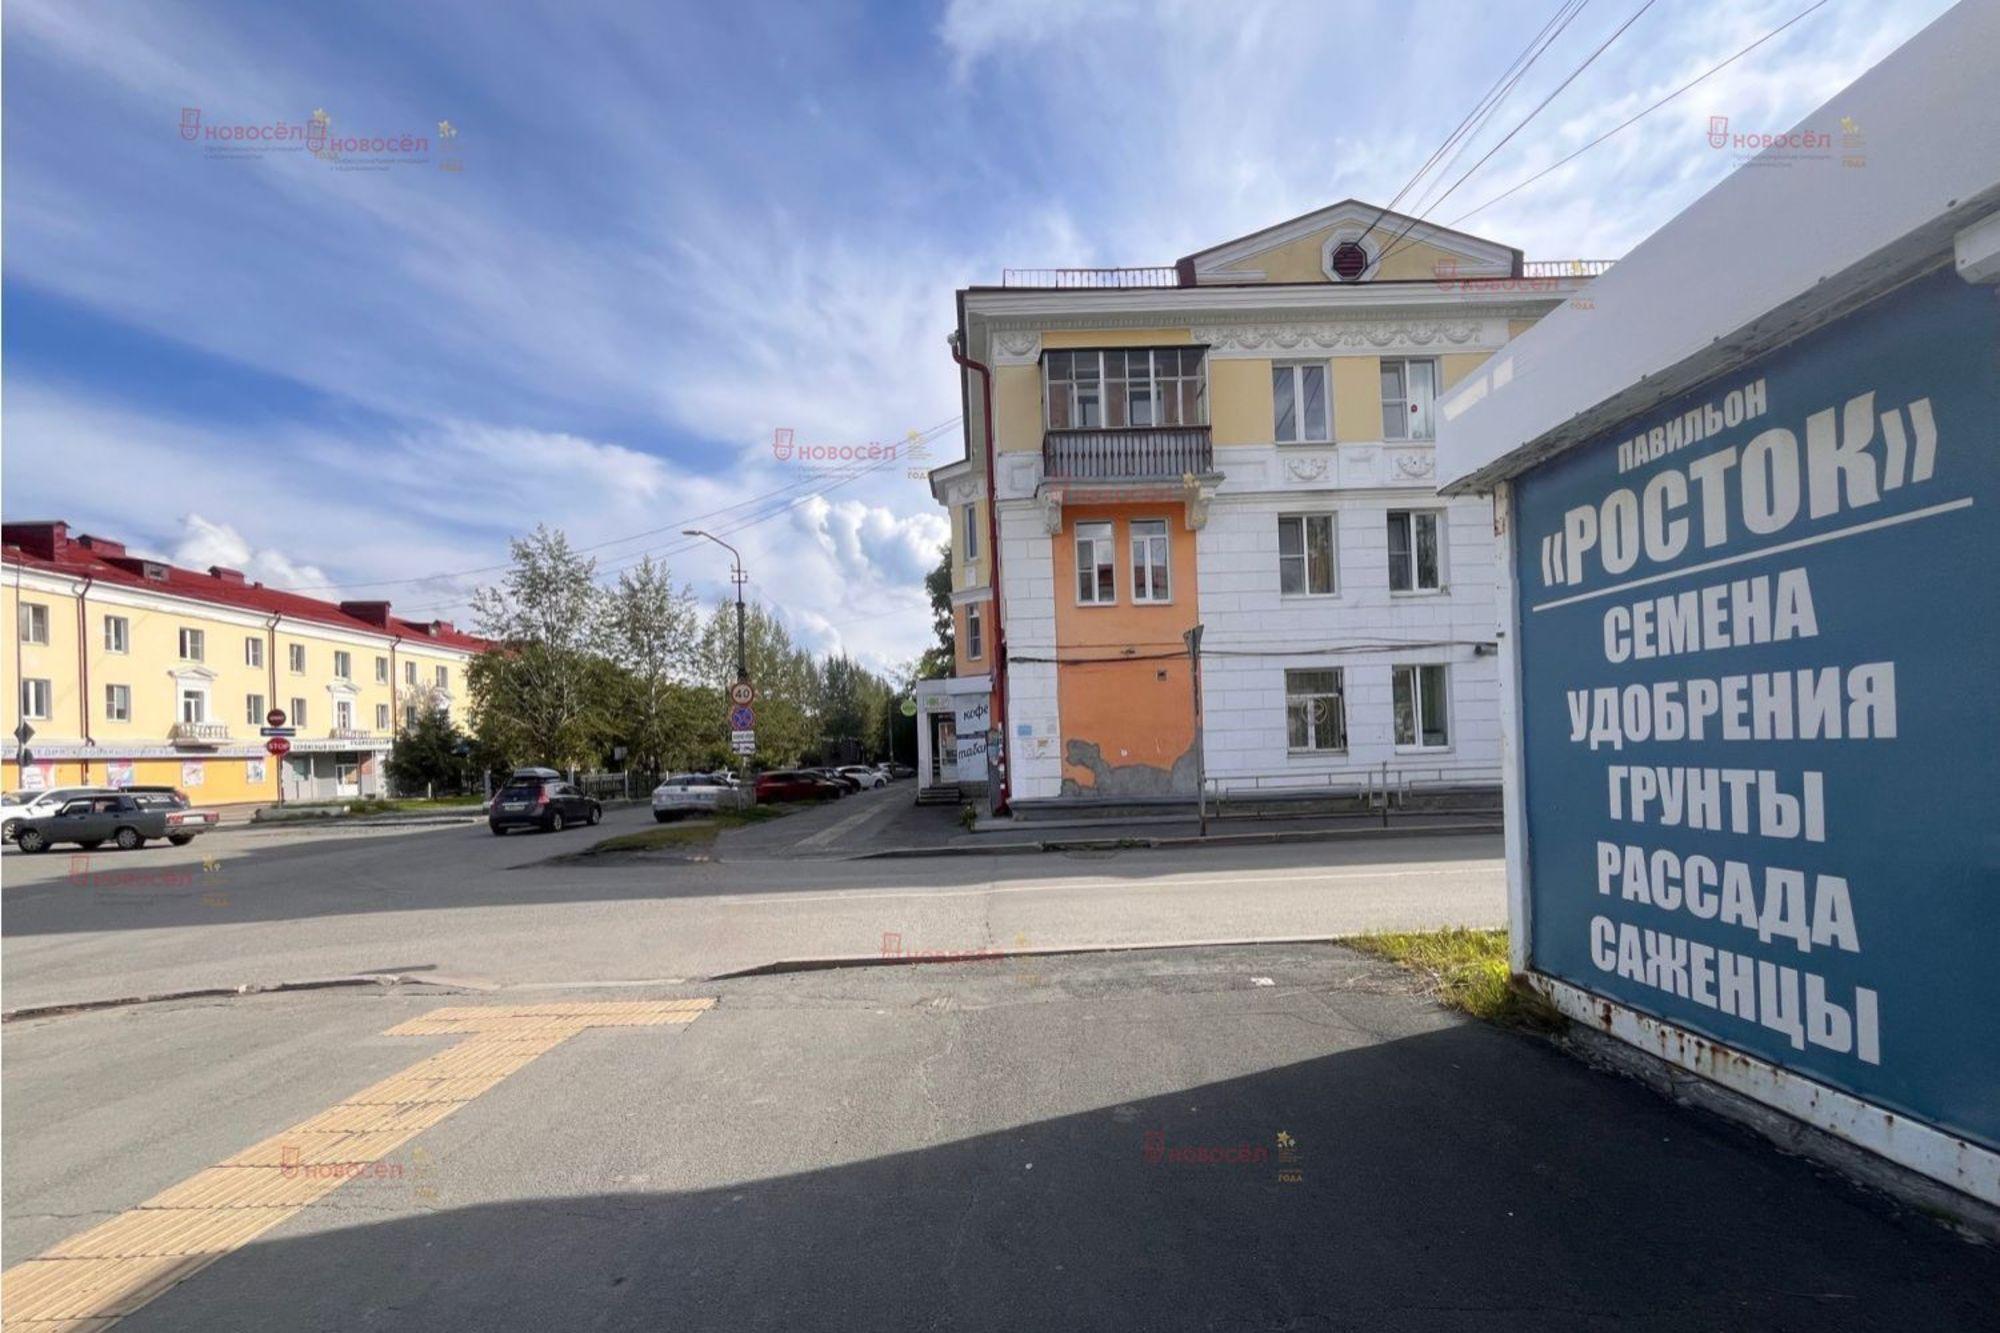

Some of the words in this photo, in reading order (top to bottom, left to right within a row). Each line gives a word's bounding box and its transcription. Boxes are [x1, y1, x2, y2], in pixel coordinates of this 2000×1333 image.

[1618, 379, 1767, 474] ПАВИЛЬОН
[1541, 390, 1937, 587] «РОСТОК»
[1603, 567, 1818, 663] СЕМЕНА
[735, 688, 750, 698] 40
[963, 703, 989, 721] кофе
[1567, 661, 1897, 750] УДОБРЕНИЯ
[268, 741, 290, 750] STOP
[1608, 766, 1825, 842] ГРУНТЫ
[1597, 841, 1860, 953] РАССАДА
[1589, 915, 1881, 1066] САЖЕНЦЫ
